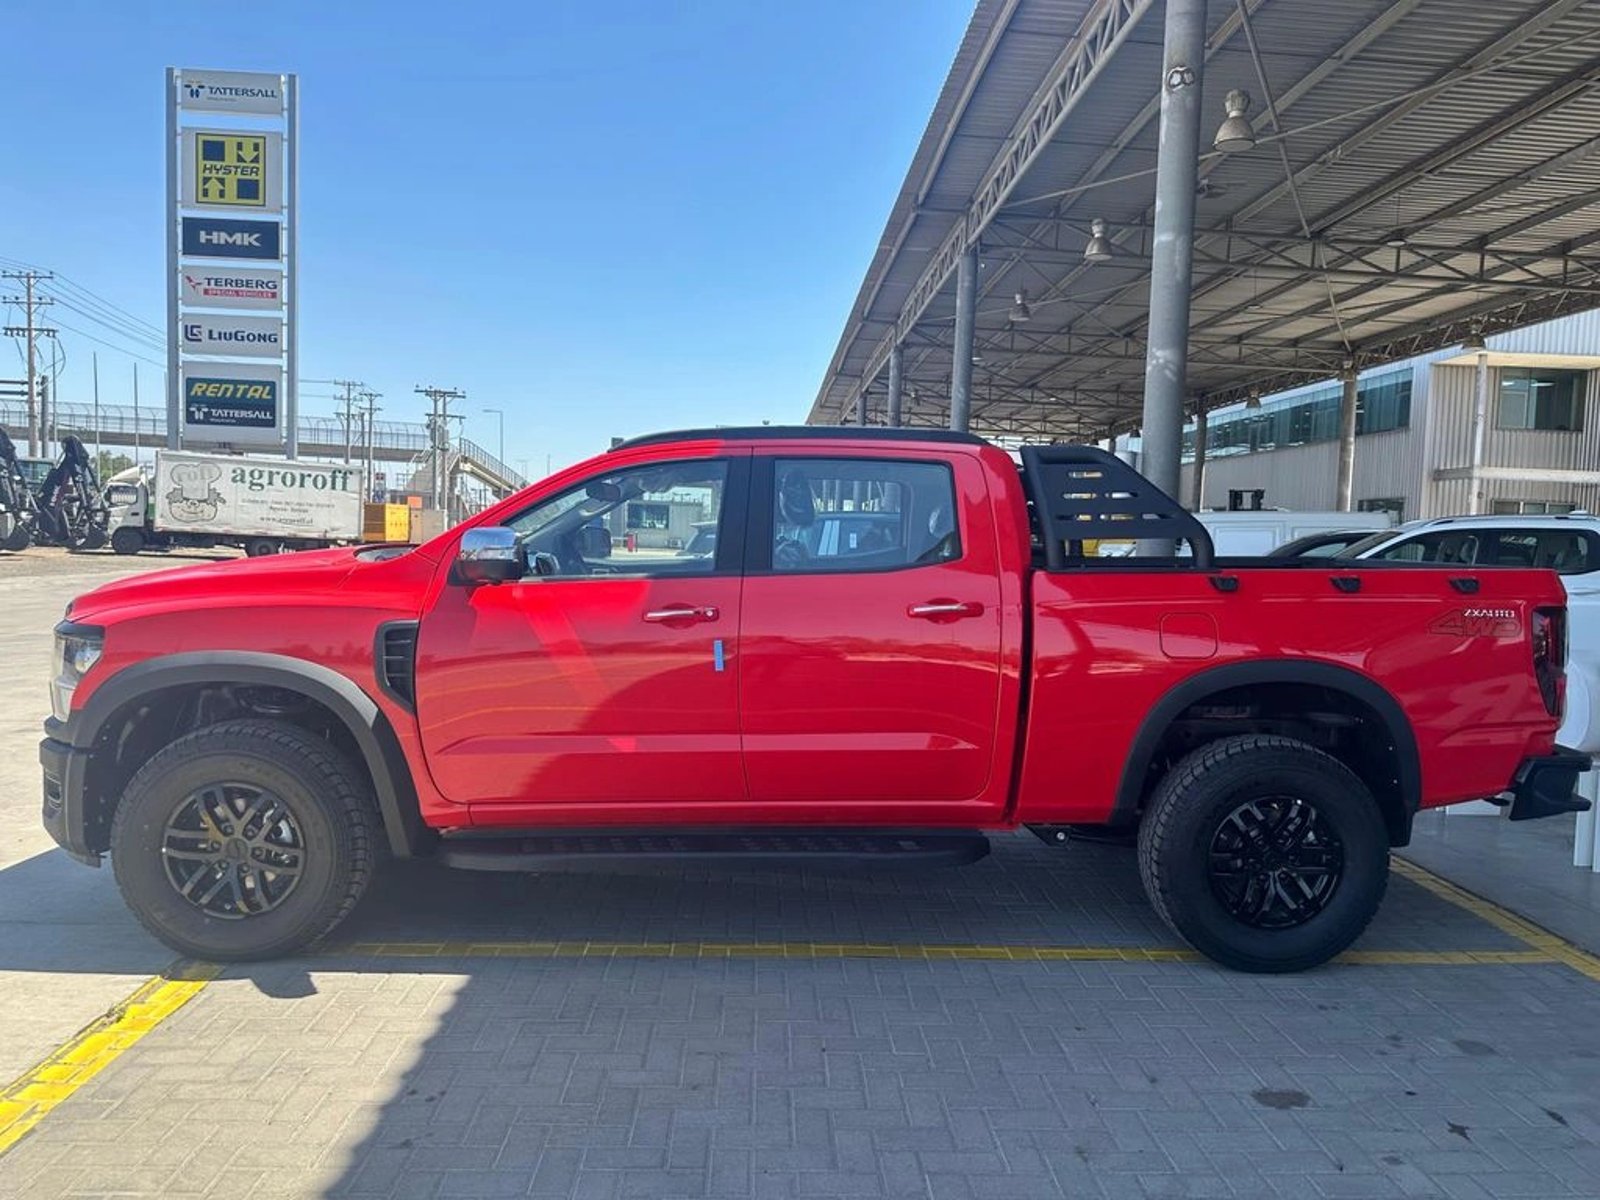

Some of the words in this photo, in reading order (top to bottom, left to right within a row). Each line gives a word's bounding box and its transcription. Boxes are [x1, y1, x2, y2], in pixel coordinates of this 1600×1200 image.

[208, 86, 277, 98] TATTERSALL
[202, 164, 260, 176] HYSTER
[199, 230, 262, 247] HMK
[204, 277, 278, 290] TERBERG
[190, 383, 272, 399] RENTAL
[210, 408, 273, 420] TATTERSALL
[231, 467, 354, 491] agroroff
[1464, 608, 1515, 618] ZXAUTO
[1427, 608, 1522, 637] 4WD
